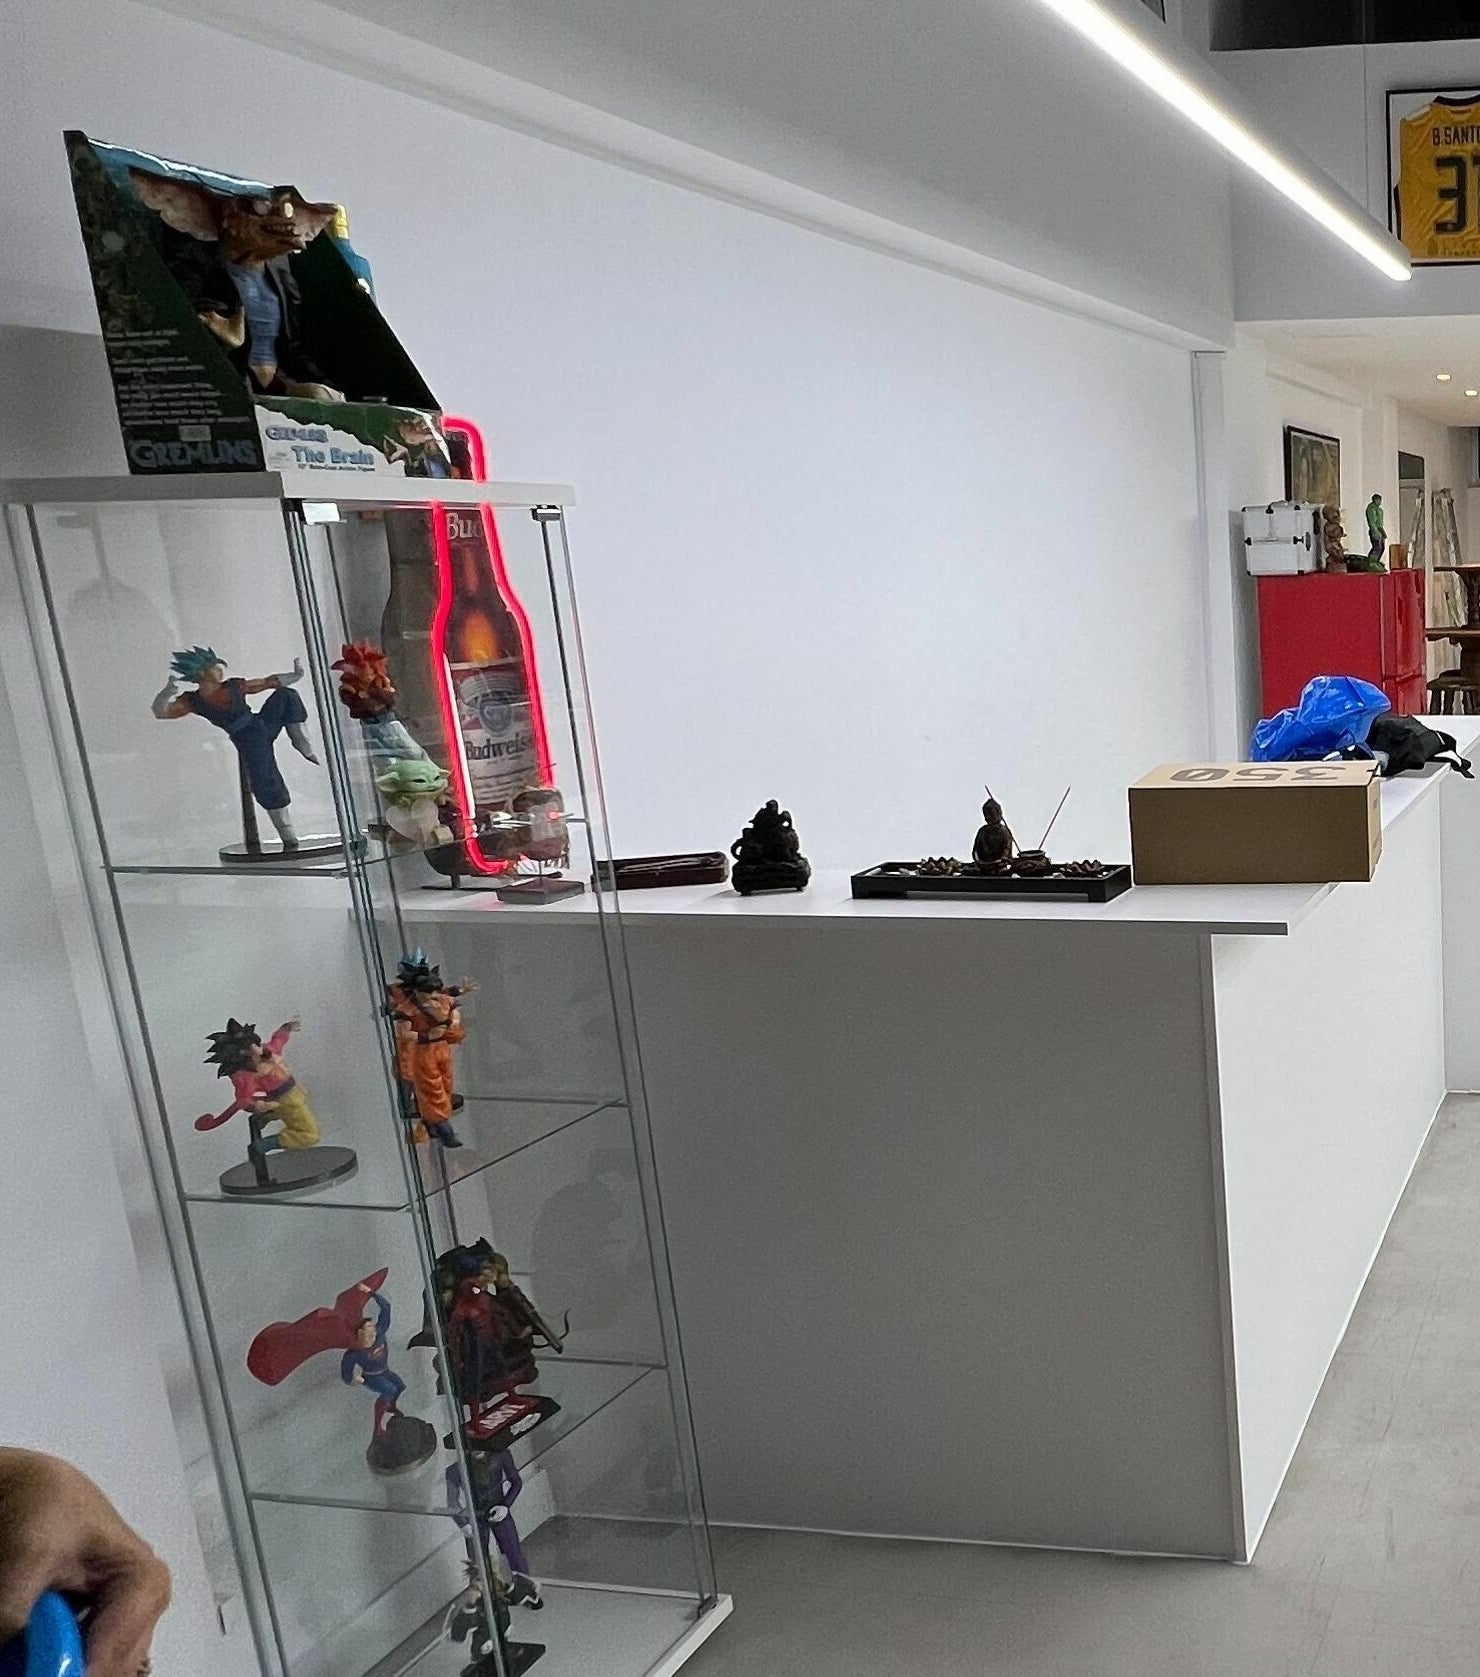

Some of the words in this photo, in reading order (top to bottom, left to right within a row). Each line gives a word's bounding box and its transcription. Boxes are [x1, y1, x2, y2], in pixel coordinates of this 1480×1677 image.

[129, 439, 258, 468] GREMLINS
[291, 445, 326, 463] The
[330, 446, 376, 465] Brain
[1170, 766, 1346, 782] 350
